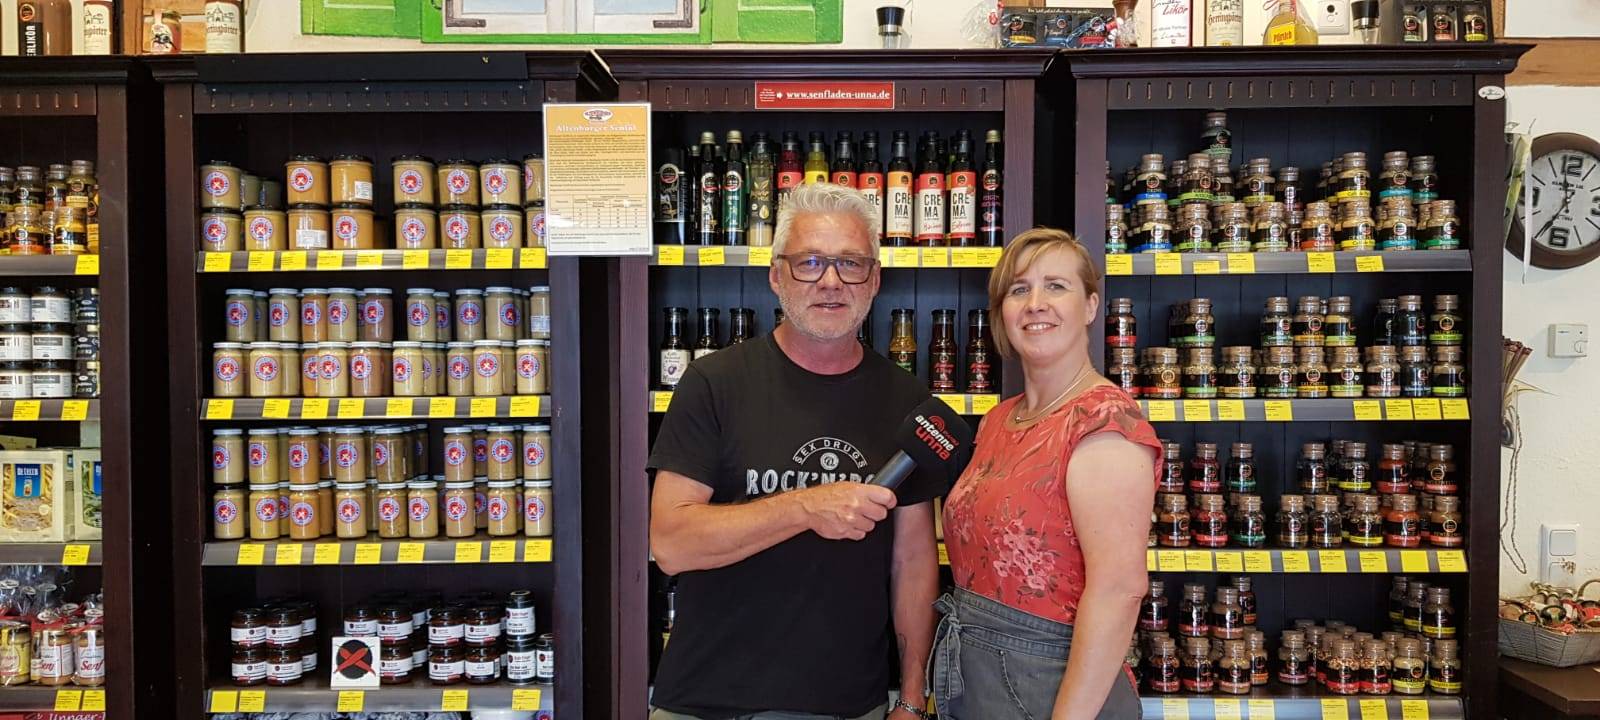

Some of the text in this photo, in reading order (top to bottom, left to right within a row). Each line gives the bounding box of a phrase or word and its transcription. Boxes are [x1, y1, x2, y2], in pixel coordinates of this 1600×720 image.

[786, 90, 890, 100] www.senfladen-unna.de
[1560, 154, 1584, 177] 12
[895, 192, 912, 204] CRE
[924, 194, 942, 206] CRE
[952, 192, 970, 205] CRE
[895, 204, 909, 216] MA
[924, 206, 939, 218] MA
[952, 205, 966, 217] MA
[1549, 226, 1570, 248] 6
[915, 414, 955, 452] antenne
[915, 426, 951, 460] unna
[795, 439, 867, 469] SEX DRUGS
[80, 658, 104, 671] Senf
